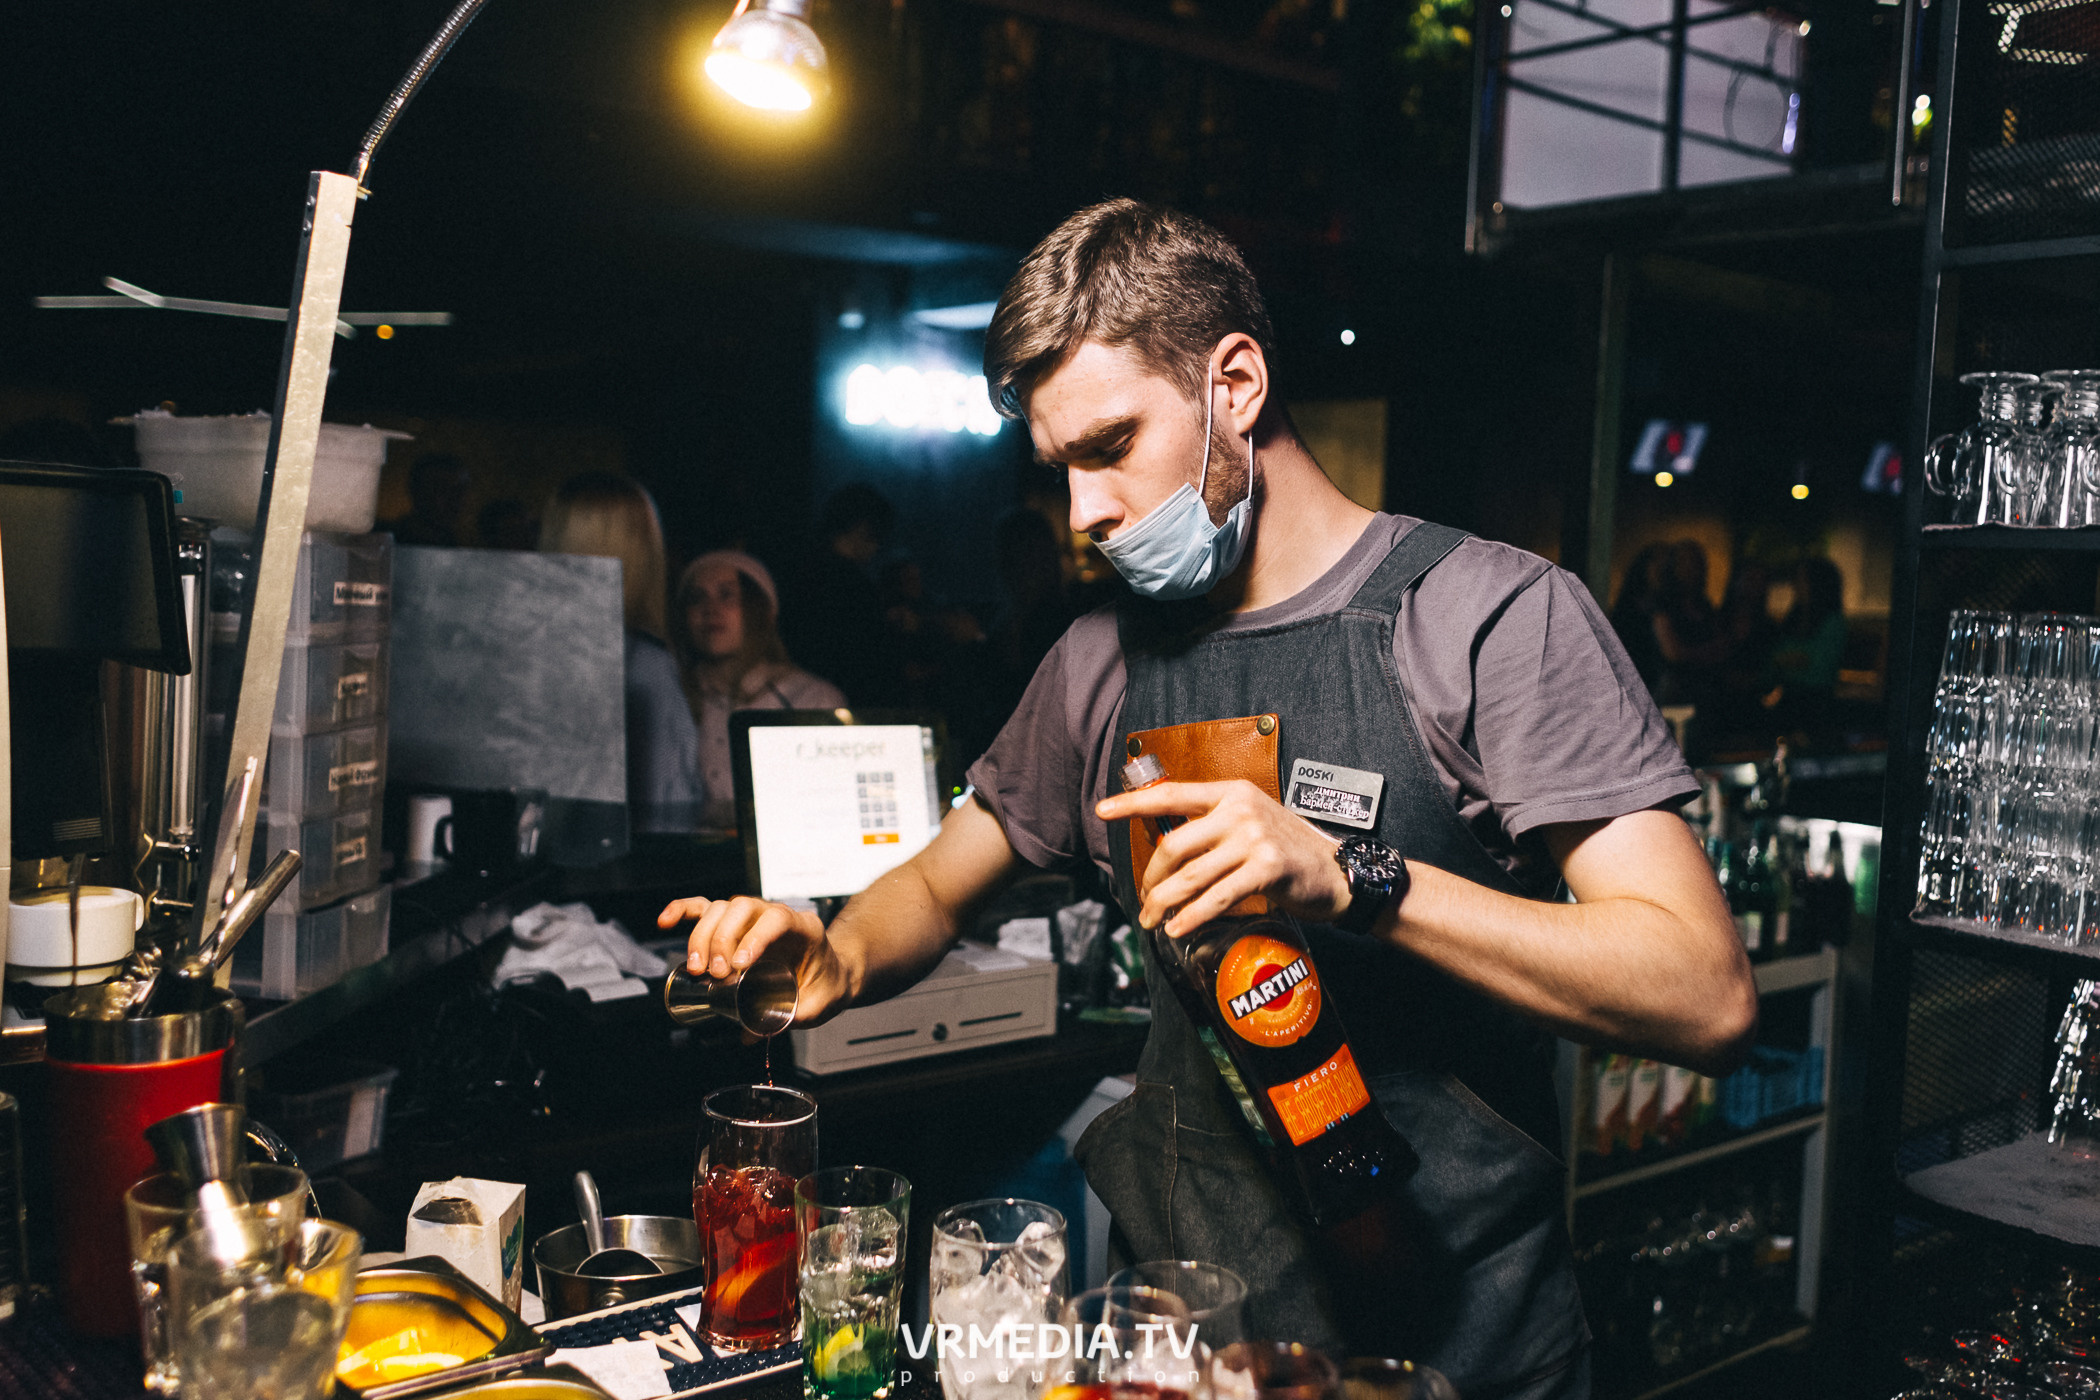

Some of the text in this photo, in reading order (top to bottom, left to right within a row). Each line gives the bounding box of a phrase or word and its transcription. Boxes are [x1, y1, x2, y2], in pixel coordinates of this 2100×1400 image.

[1297, 766, 1334, 782] DOSKI
[1230, 958, 1310, 1018] MARTINI
[1264, 1003, 1313, 1036] L'APERITIVO
[1293, 1061, 1338, 1093] FIERO
